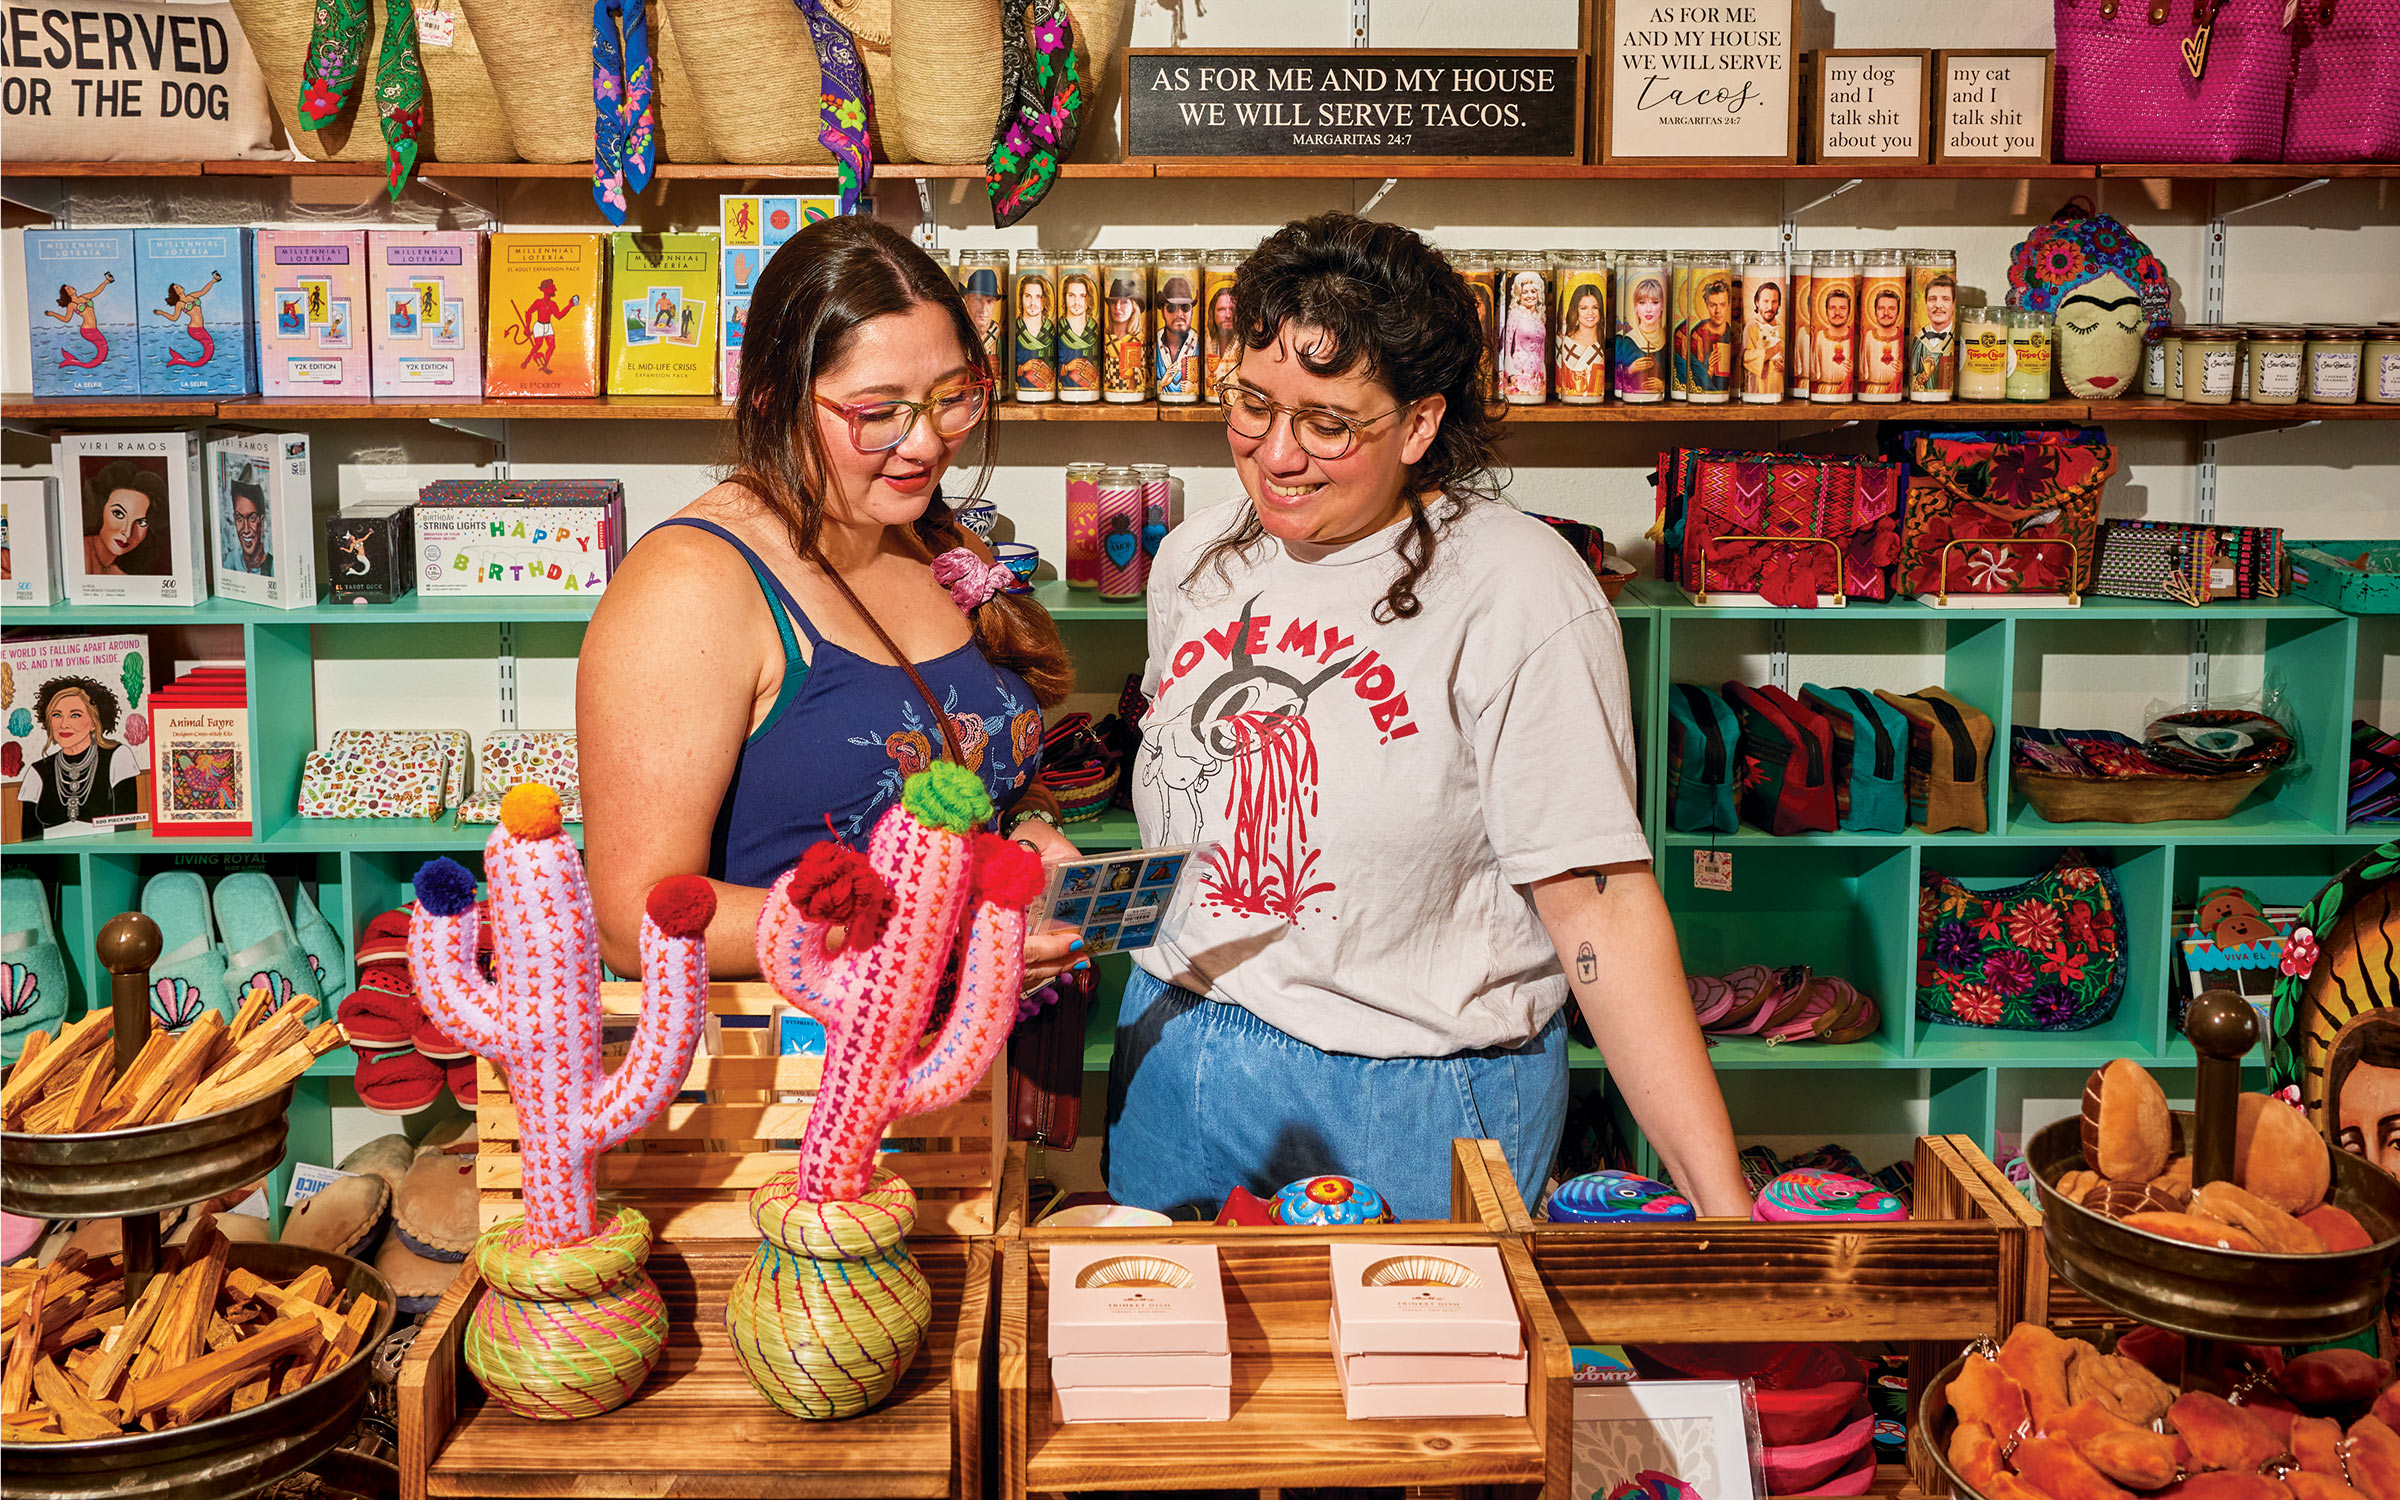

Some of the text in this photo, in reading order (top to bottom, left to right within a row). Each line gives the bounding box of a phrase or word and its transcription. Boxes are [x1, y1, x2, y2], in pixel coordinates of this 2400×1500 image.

[1650, 7, 1756, 23] AS FOR ME
[1623, 31, 1782, 47] AND MY HOUSE
[1621, 54, 1782, 70] WE WILL SERVE
[1150, 67, 1555, 93] AS FOR ME AND MY HOUSE
[1831, 65, 1895, 86] my dog
[1954, 68, 2011, 86] my cat
[0, 77, 229, 121] OR THE DOG
[1637, 74, 1764, 114] tacos.
[1830, 87, 1873, 103] and I
[1952, 87, 1996, 103] and I
[1178, 103, 1527, 128] WE WILL SERVE TACOS.
[1659, 117, 1741, 125] MARGARITAS 24:7
[1830, 109, 1900, 125] talk shit
[1952, 109, 2023, 125] talk shit
[1293, 134, 1412, 145] MARGARITAS 24:7
[1829, 132, 1912, 152] about you
[1951, 131, 2035, 152] about you
[1967, 348, 1988, 360] Topo
[2016, 349, 2037, 360] Topo
[628, 363, 697, 371] EL MID-LIFE CRISIS
[80, 442, 167, 450] VIRI RAMOS
[238, 440, 269, 452] RAMOS
[423, 522, 487, 530] STRING LIGHTS
[490, 521, 591, 553] HAPPY
[453, 553, 602, 591] BIRTHDAY
[17, 582, 32, 590] 500
[161, 580, 177, 589] 500
[9, 639, 140, 659] WORLD IS FALLING APART AROUND
[16, 661, 29, 671] US,
[31, 659, 48, 670] AND
[50, 658, 64, 668] I'M
[66, 655, 91, 667] DYING
[1276, 617, 1354, 665] MY
[1341, 650, 1419, 746] JOB!
[169, 714, 234, 730] Animal Fayre
[175, 854, 267, 865] LIVING ROYAL
[2224, 952, 2266, 961] VIVA EL
